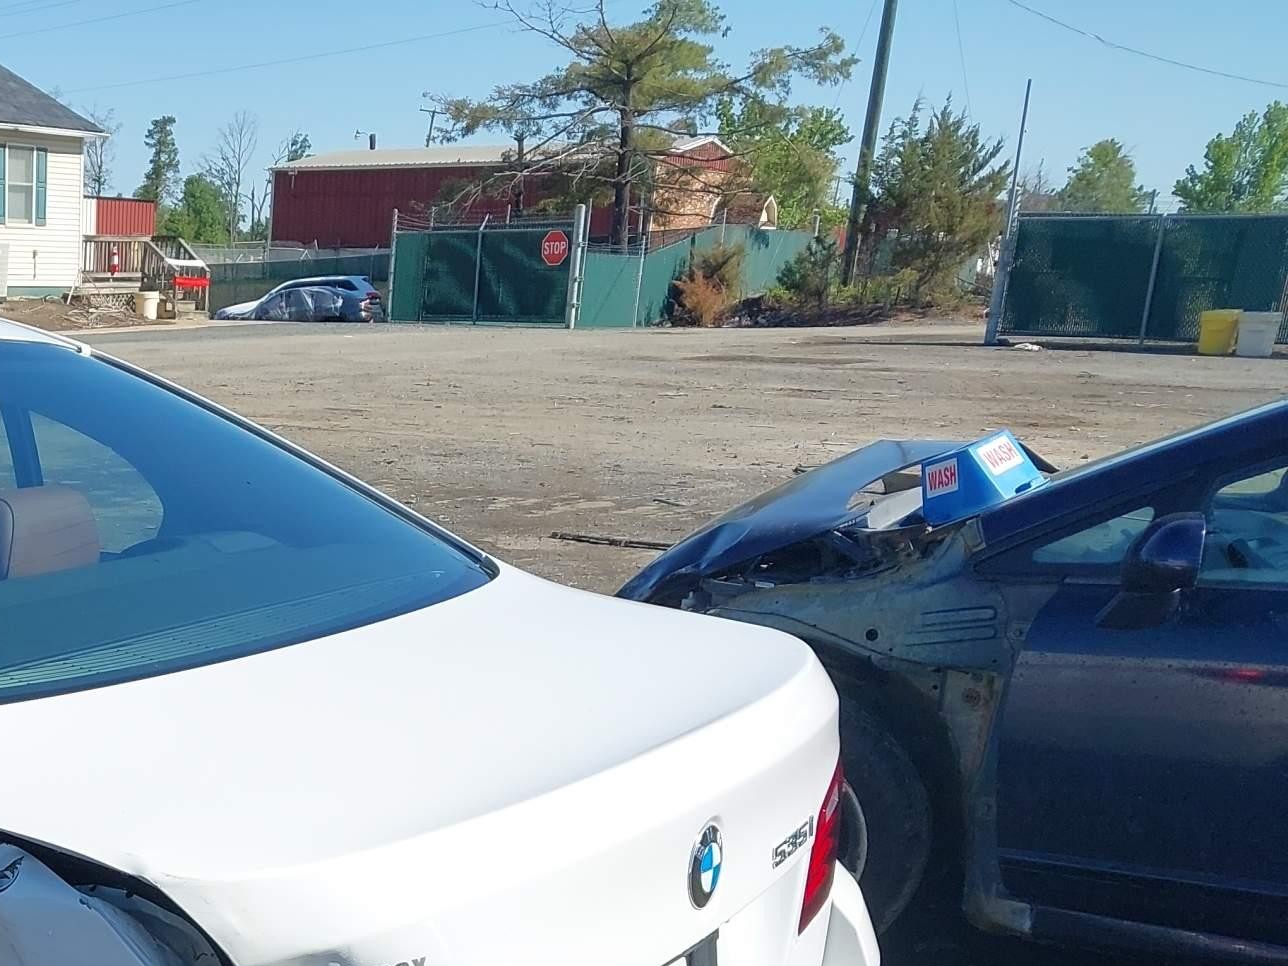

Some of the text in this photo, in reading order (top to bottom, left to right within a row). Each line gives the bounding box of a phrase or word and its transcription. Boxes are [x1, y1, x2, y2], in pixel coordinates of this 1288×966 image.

[543, 241, 567, 255] STOP
[982, 441, 1018, 469] WASH
[927, 463, 957, 492] WASH
